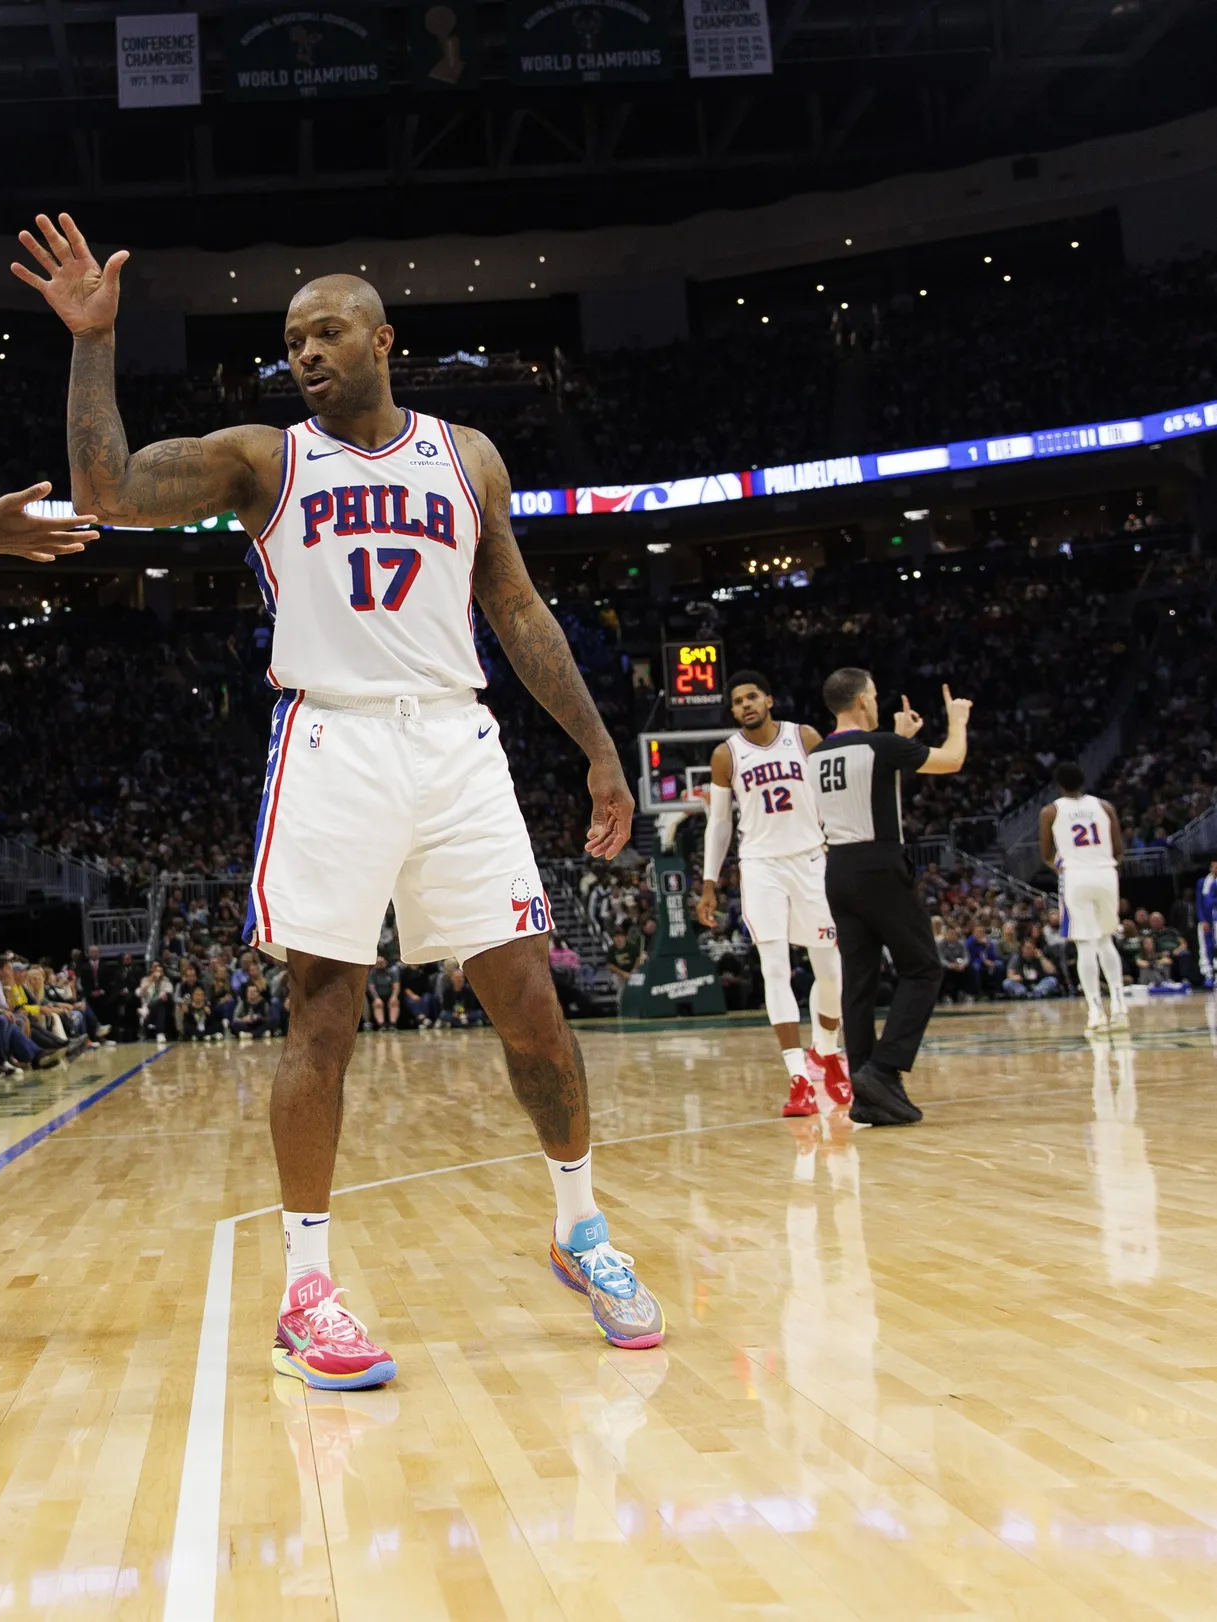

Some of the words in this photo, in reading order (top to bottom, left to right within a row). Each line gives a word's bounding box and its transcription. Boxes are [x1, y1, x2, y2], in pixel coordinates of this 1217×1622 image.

[122, 35, 195, 52] CONFERENCE
[126, 50, 192, 67] CHAMPIONS
[520, 54, 573, 73] WORLD
[576, 48, 662, 70] CHAMPIONS
[236, 68, 289, 88] WORLD
[293, 64, 379, 85] CHAMPIONS
[1164, 412, 1202, 434] 65%
[410, 459, 451, 468] crypto.com
[763, 455, 864, 496] PHILADELPHIA
[511, 490, 552, 515] 100
[300, 484, 457, 550] PHILA
[347, 547, 422, 612] 17
[676, 664, 715, 693] 24
[740, 760, 804, 793] PHILA
[819, 756, 848, 794] 29
[761, 786, 794, 815] 12
[1071, 822, 1102, 848] 21
[511, 896, 546, 933] 76
[817, 927, 837, 941] 76
